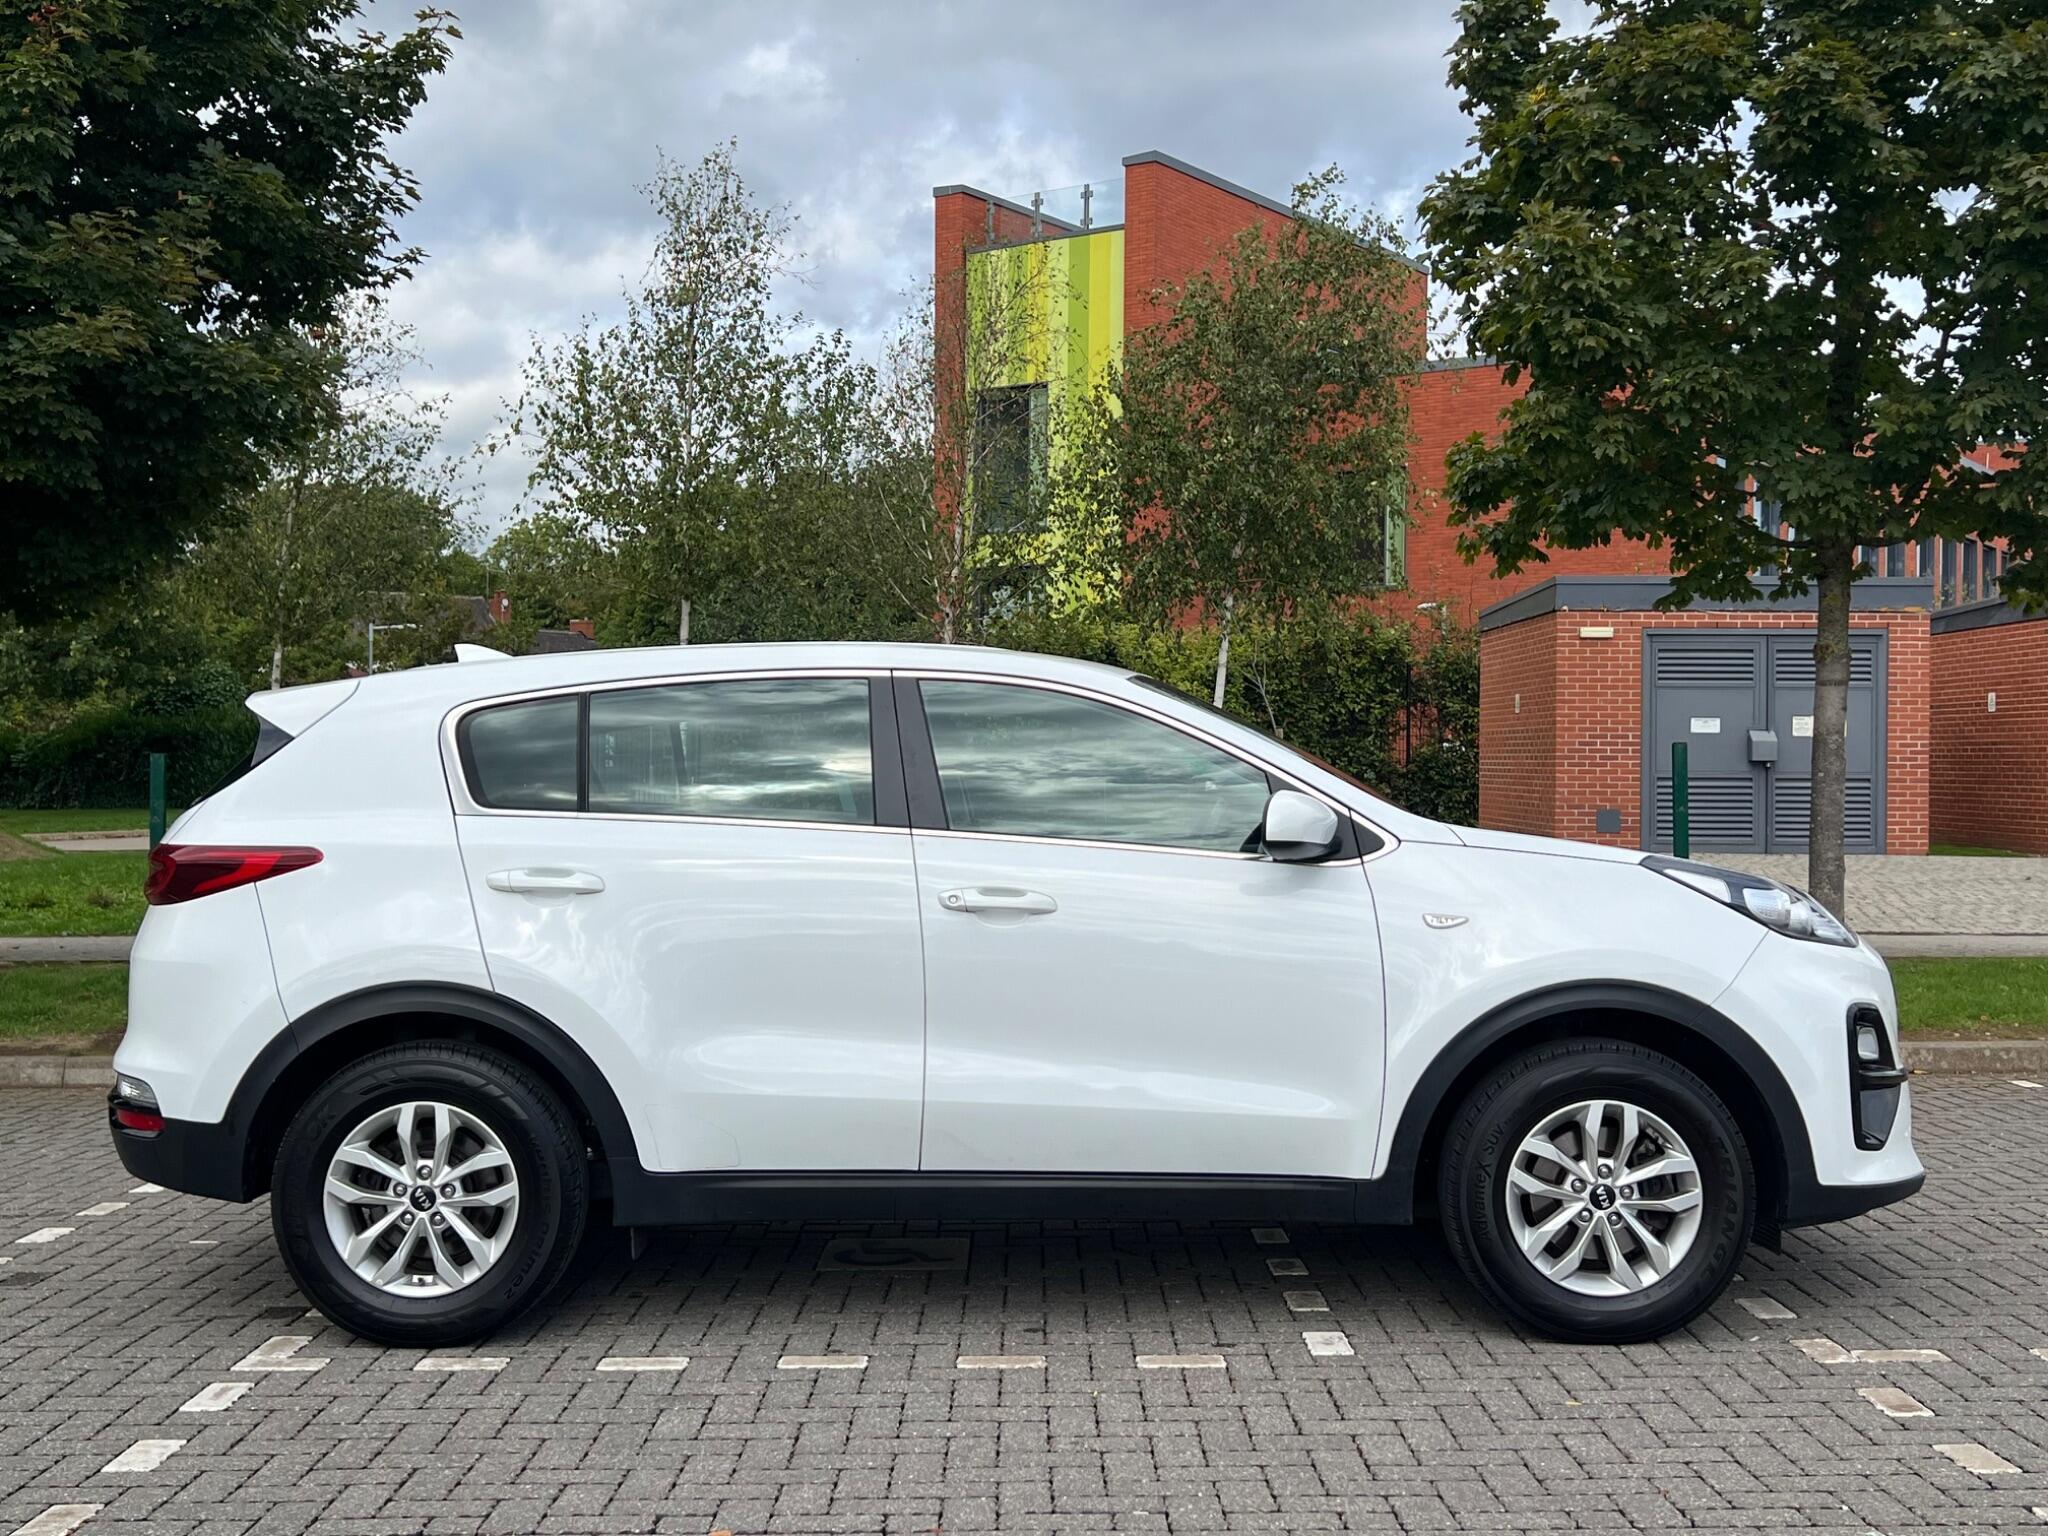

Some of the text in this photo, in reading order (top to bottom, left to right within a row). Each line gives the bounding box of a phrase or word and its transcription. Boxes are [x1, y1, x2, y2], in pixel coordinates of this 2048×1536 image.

[1481, 1123, 1504, 1156] SUV
[415, 1188, 432, 1210] KIA
[1596, 1186, 1611, 1209] KIA
